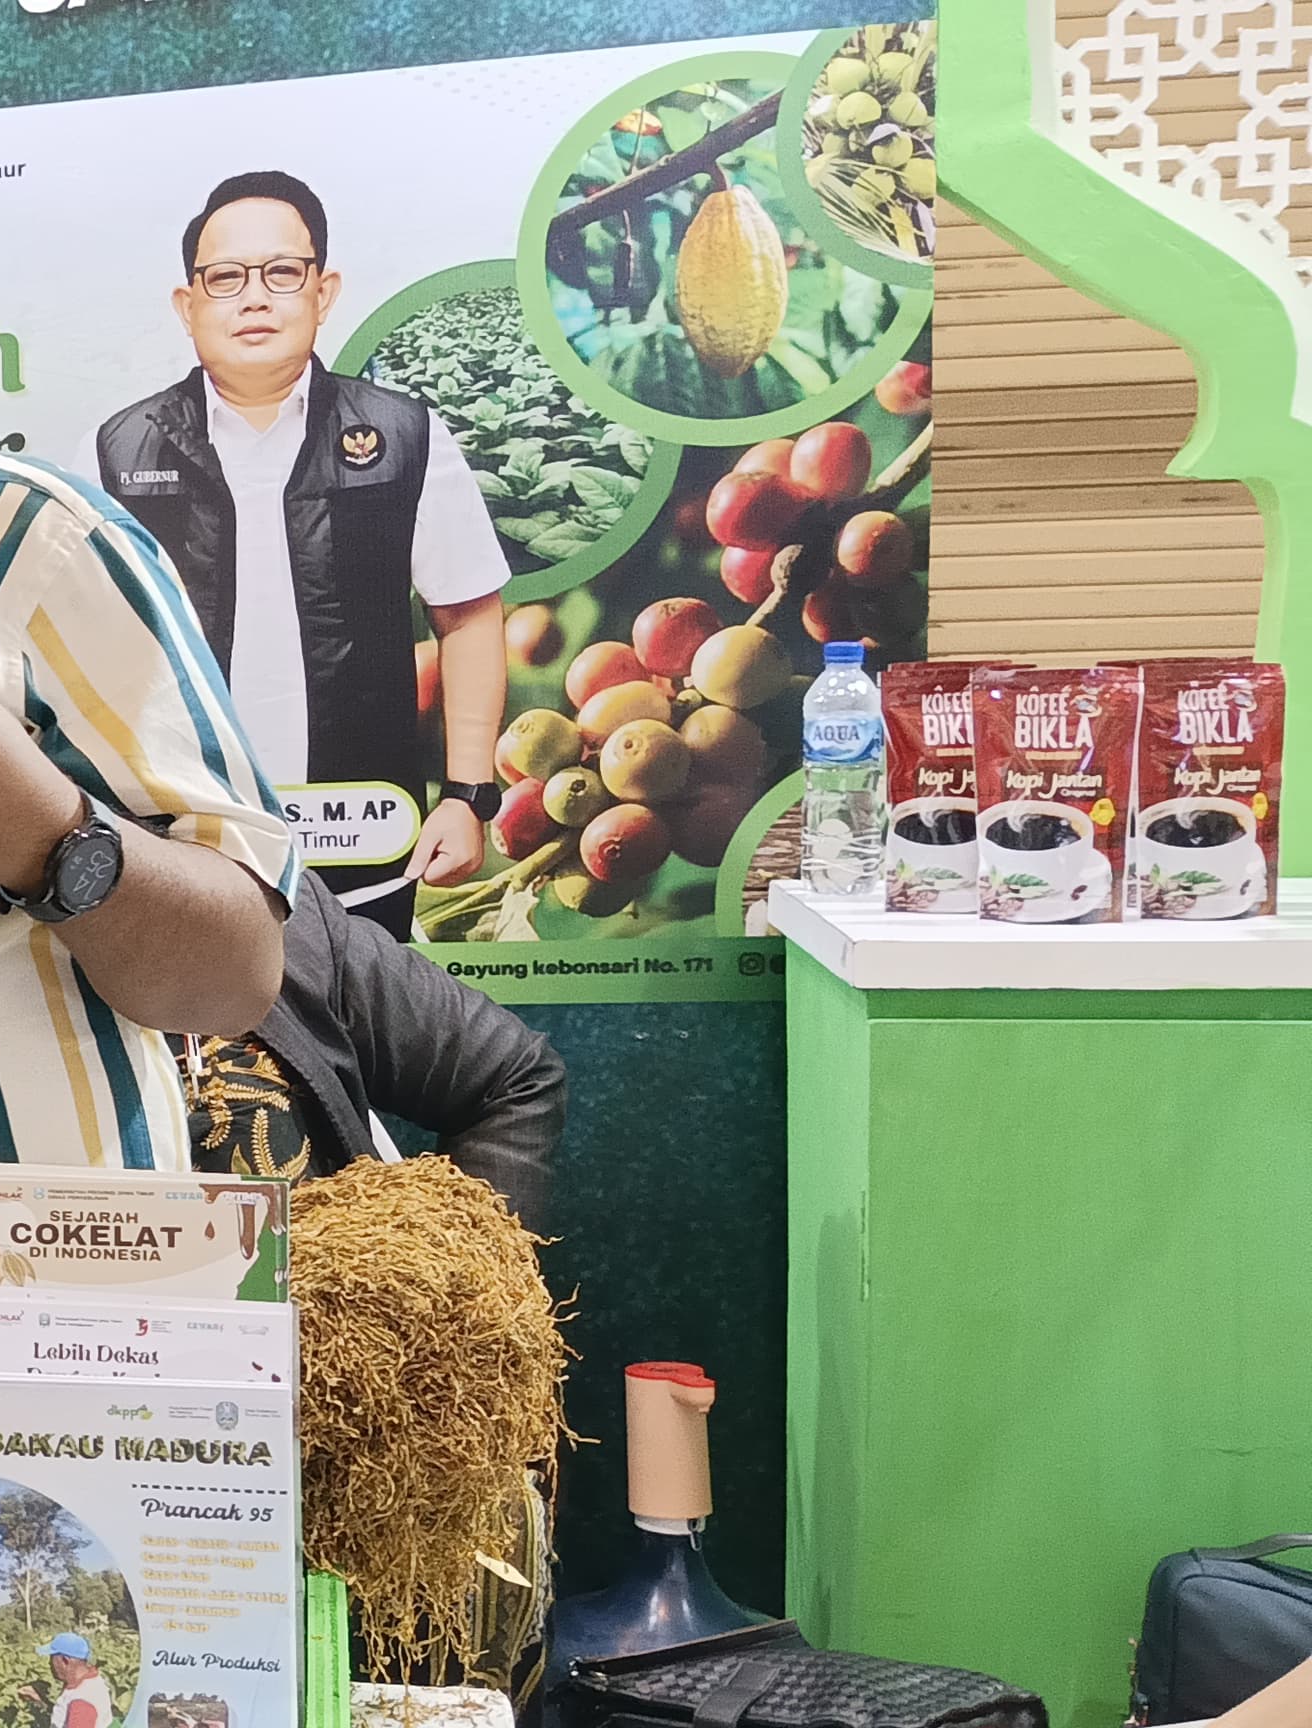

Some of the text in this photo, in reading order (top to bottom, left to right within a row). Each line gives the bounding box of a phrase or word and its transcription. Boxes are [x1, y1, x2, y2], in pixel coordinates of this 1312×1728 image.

[813, 725, 861, 744] AQUA
[1014, 714, 1095, 749] BIKLA
[1179, 709, 1254, 744] BIKLA
[918, 767, 954, 793] Kopi
[1006, 769, 1044, 796] Kopi
[1174, 767, 1213, 792] Kopi
[323, 801, 352, 821] M.
[362, 800, 396, 820] AP
[298, 830, 360, 849] Timur
[447, 960, 527, 979] Gayung
[533, 957, 639, 975] kebonsari
[684, 957, 713, 972] 171
[49, 1210, 139, 1224] SEJARAH
[9, 1222, 183, 1248] COKELAT
[29, 1246, 162, 1262] DI INDONESIA
[33, 1342, 159, 1365] Lebih Dekat
[114, 1435, 273, 1467] MADURA
[141, 1497, 274, 1522] Prancak 95
[152, 1649, 280, 1673] Alur Produksi
